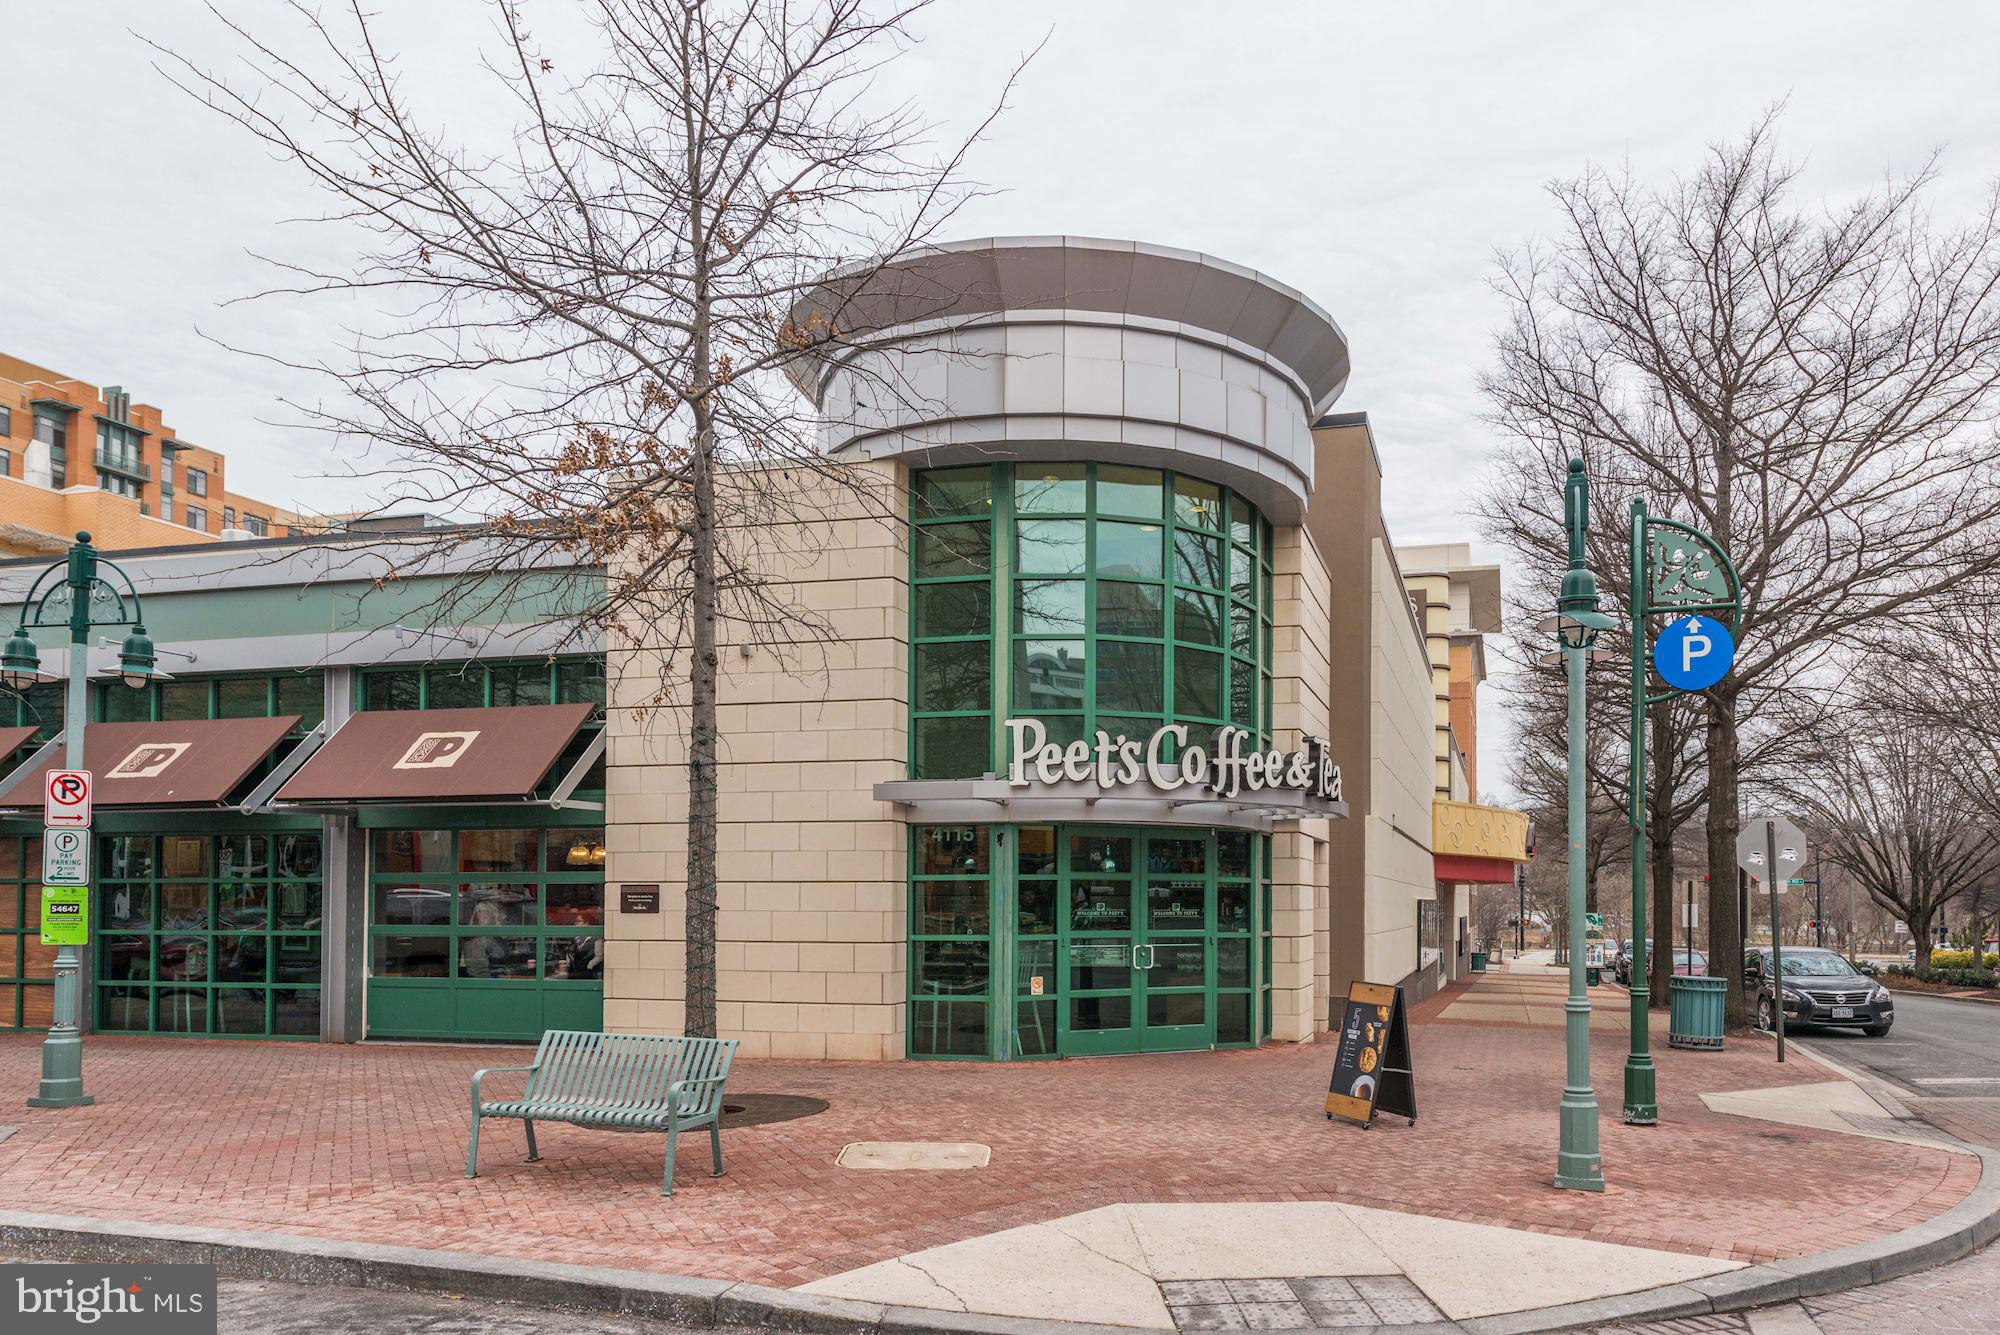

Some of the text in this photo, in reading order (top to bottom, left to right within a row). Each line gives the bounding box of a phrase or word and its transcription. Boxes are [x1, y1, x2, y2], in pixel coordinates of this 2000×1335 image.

[1683, 635, 1712, 672] P
[1005, 718, 1343, 802] Peet's Coffee & Tea
[931, 826, 975, 842] 4115
[63, 835, 73, 849] P
[56, 866, 63, 876] 2
[51, 905, 79, 913] 54647
